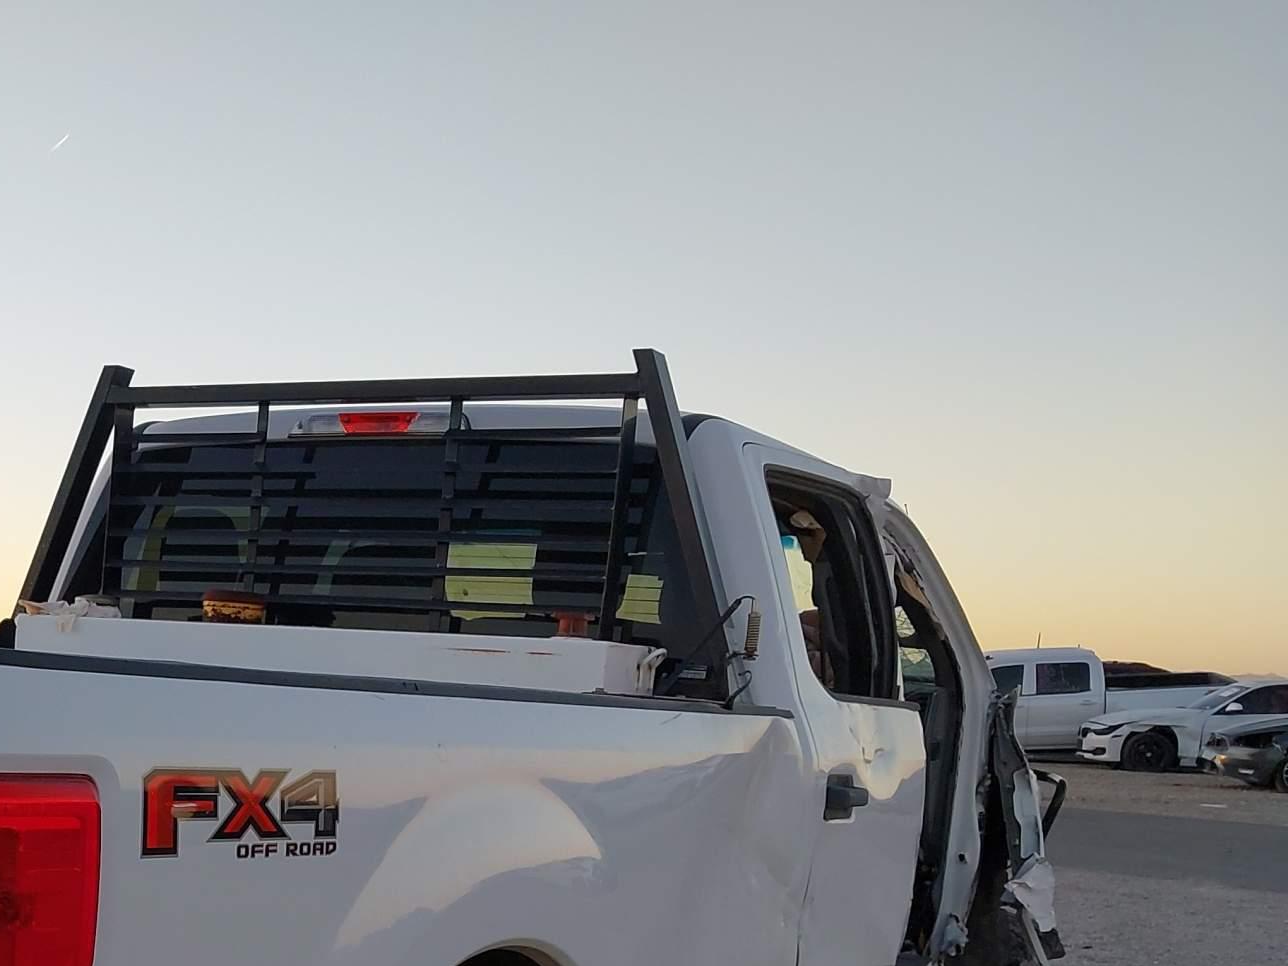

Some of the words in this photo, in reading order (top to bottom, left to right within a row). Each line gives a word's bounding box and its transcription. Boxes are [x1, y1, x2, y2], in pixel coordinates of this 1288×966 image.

[141, 768, 339, 858] FX4
[236, 842, 278, 858] OFF
[285, 841, 337, 856] ROAD
